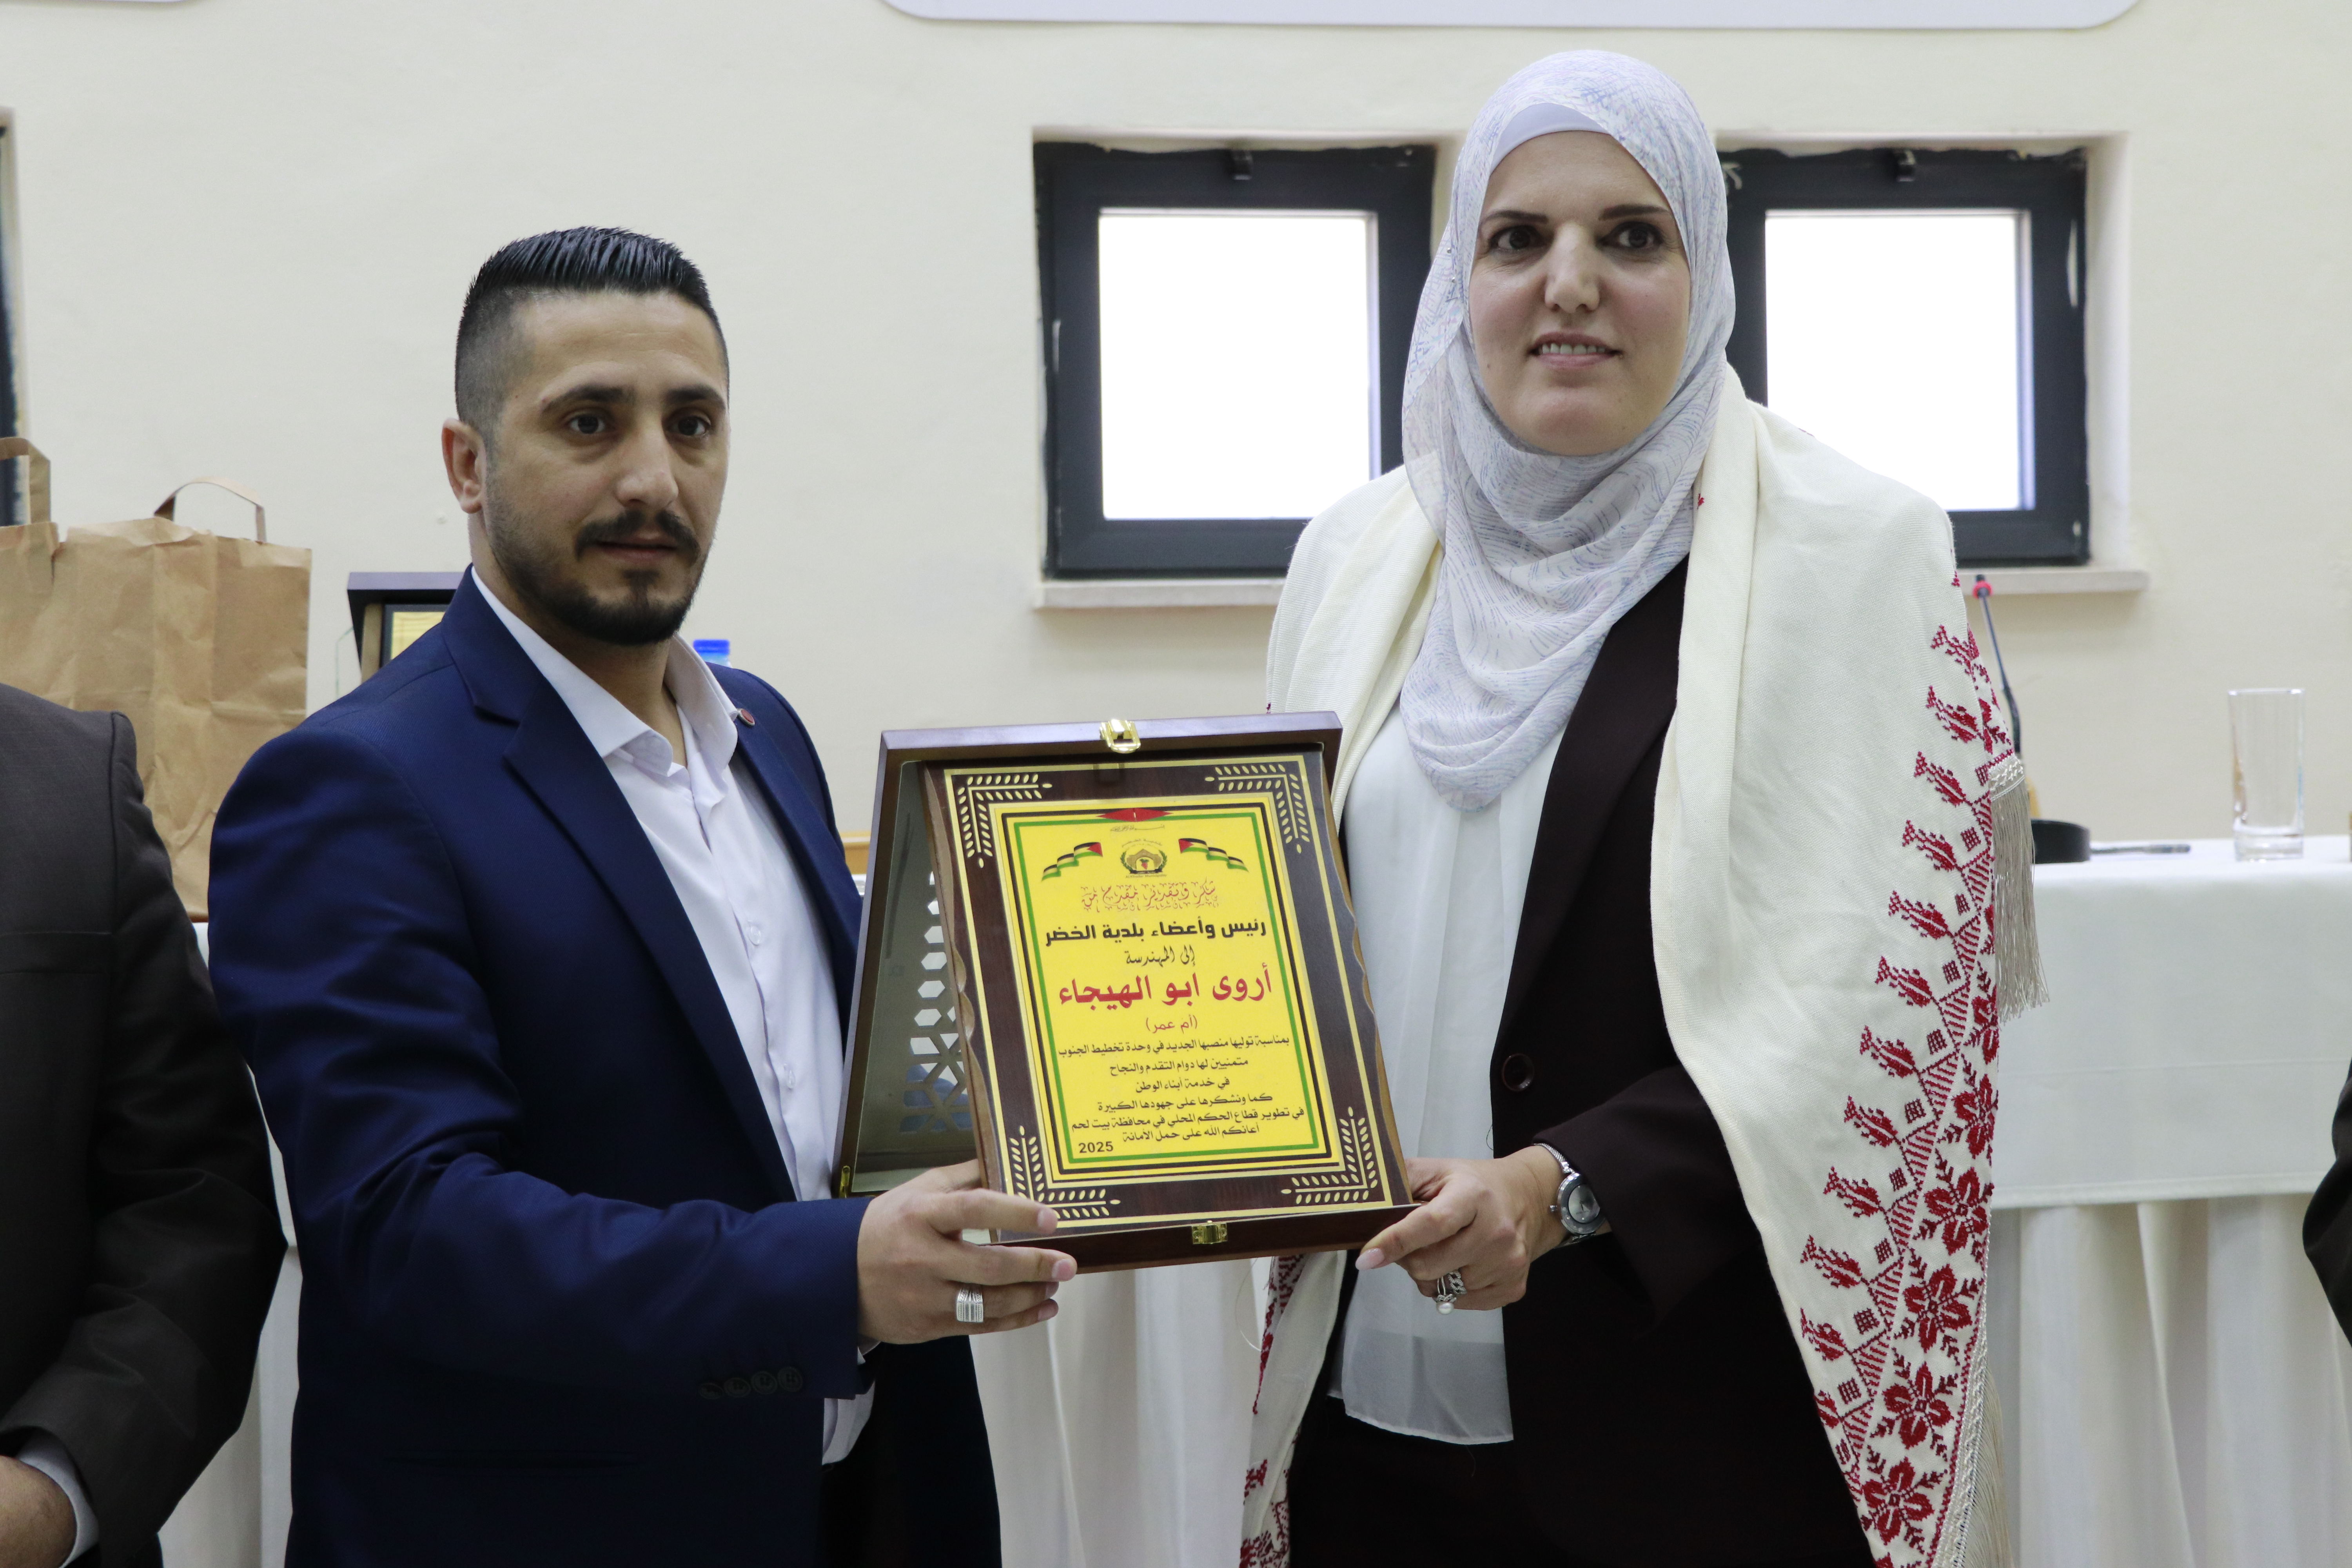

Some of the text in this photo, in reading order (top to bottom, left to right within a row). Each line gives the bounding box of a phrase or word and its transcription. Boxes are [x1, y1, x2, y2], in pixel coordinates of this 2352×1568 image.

[1046, 916, 1266, 947] رئيس وأعضاء بلدية الخضر
[1124, 944, 1195, 967] إلى المهندسة
[1059, 962, 1272, 1010] أروى ابو الهيجاء
[1059, 1035, 1290, 1058] بمناسبة توليها منصبها الجديد في وحدة تخطيط الجنوب
[1110, 1057, 1248, 1076] متمنيين لها دوام التقدم والنجاح
[1136, 1080, 1162, 1093] الوطن
[1185, 1078, 1215, 1089] خدمة
[1218, 1076, 1230, 1090] في
[1098, 1093, 1273, 1113] كما ونشكرها على جهودها الكبيرة
[1072, 1107, 1304, 1132] في تطوير قطاع الحكم المحلي في محافظة بيت لحم
[1156, 1130, 1180, 1142] حمل
[1183, 1128, 1202, 1140] على
[1204, 1125, 1220, 1136] الله
[1222, 1122, 1259, 1138] أعانكم
[1078, 1141, 1114, 1153] 2025
